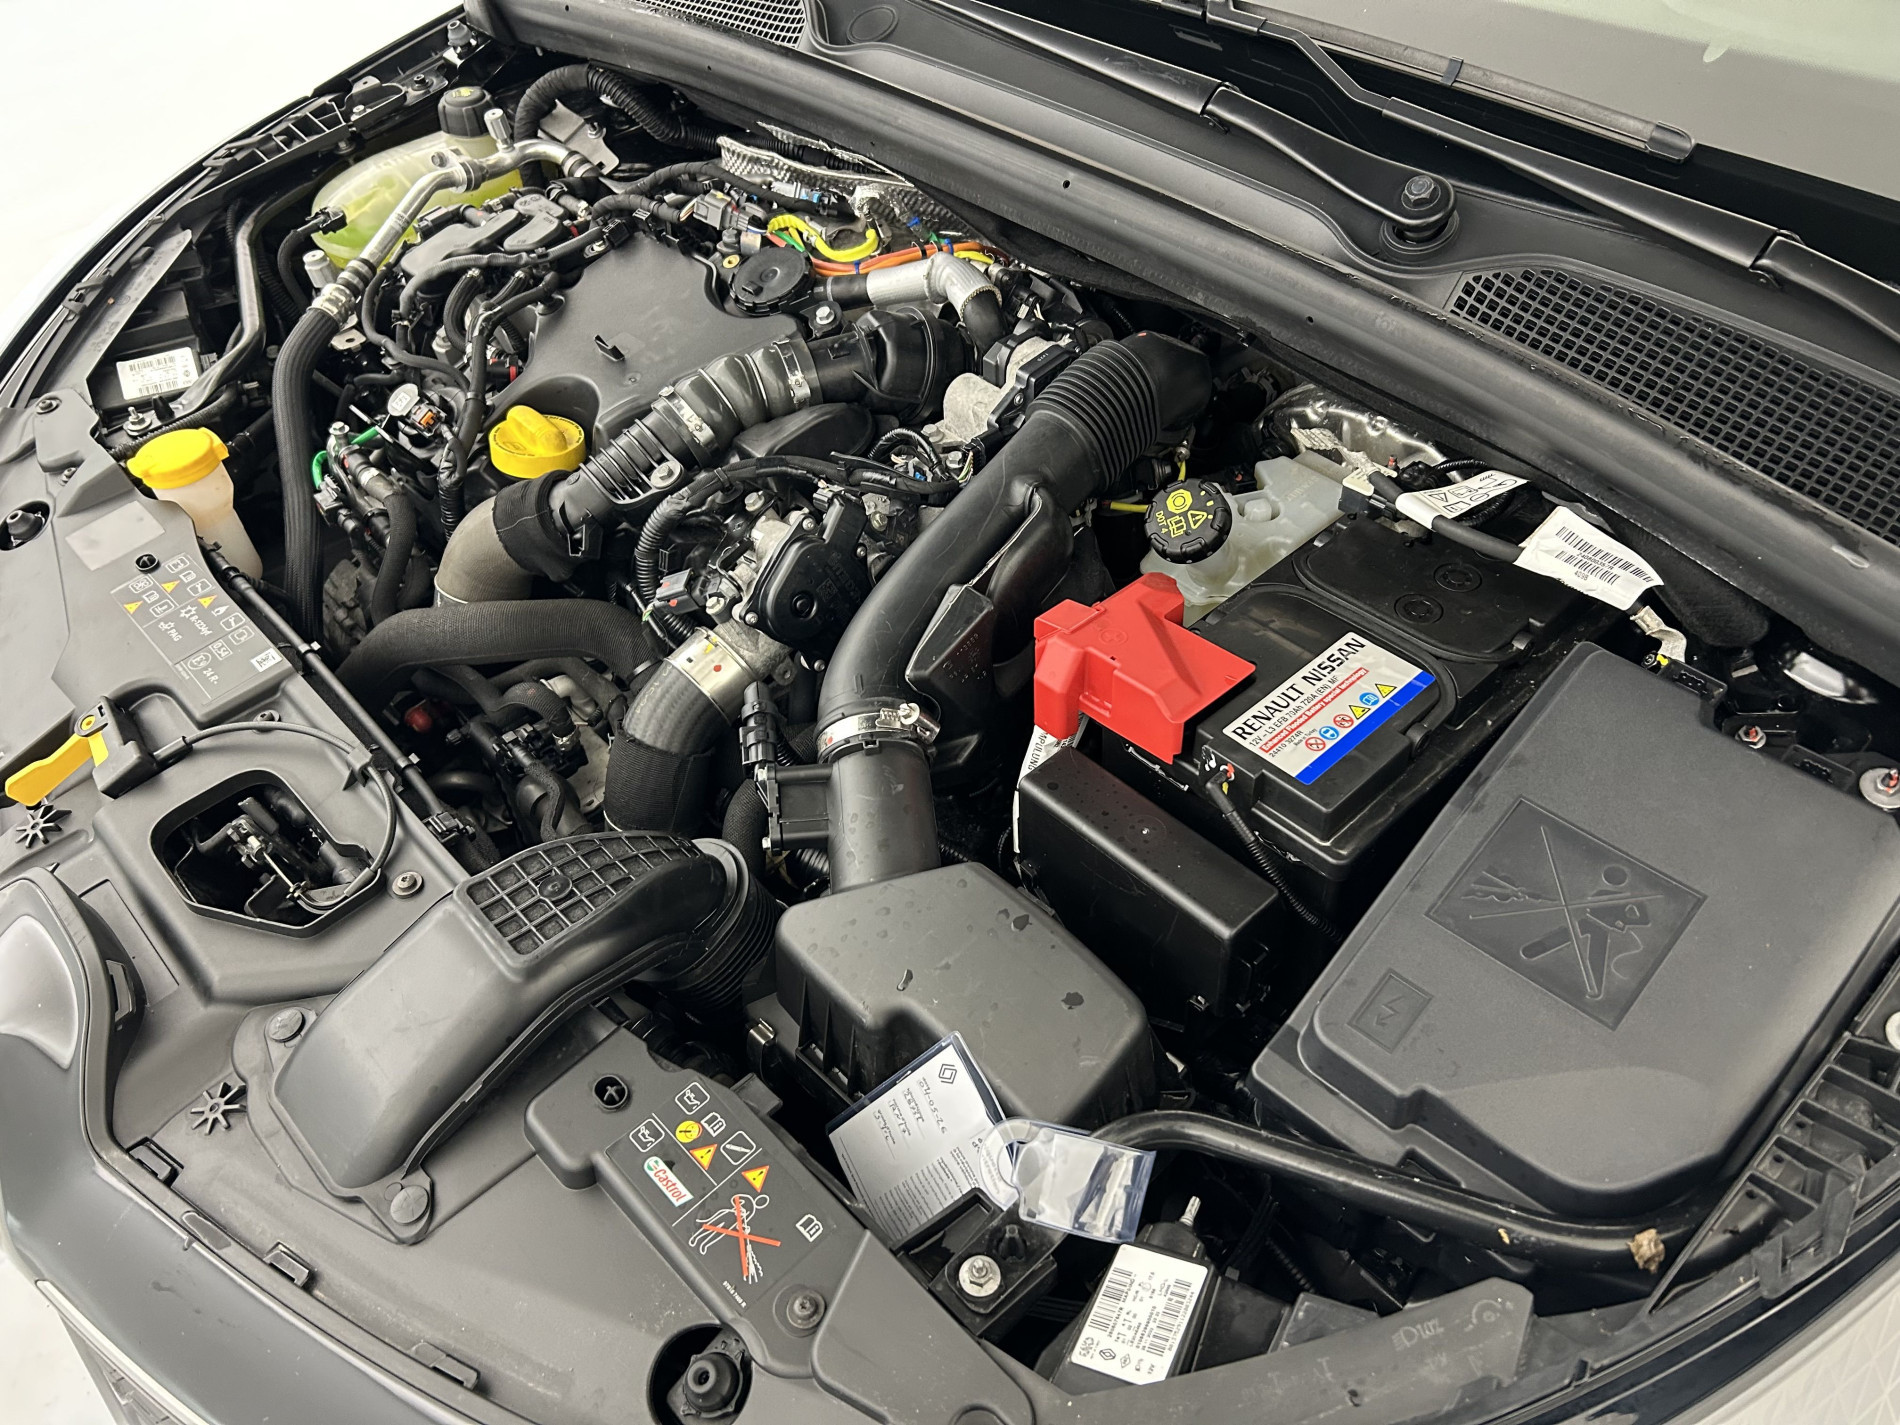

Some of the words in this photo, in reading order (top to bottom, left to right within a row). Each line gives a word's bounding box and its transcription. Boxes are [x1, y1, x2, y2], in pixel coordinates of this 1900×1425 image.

[1155, 510, 1167, 526] DOT
[167, 627, 182, 642] PAG
[202, 667, 213, 678] 24
[1232, 683, 1305, 741] RENAULT
[1301, 637, 1366, 686] NISSAN
[1249, 735, 1263, 747] 12V
[1267, 726, 1276, 735] L3
[1273, 716, 1288, 729] EFB
[1288, 704, 1303, 718] 70Ah
[1302, 692, 1318, 707] 720A
[1317, 683, 1331, 697] (EN)
[1328, 675, 1338, 685] MF
[1263, 729, 1287, 750] Enhanced
[1285, 714, 1306, 732] Flooded
[1304, 701, 1324, 718] Battery
[1322, 687, 1341, 705] special
[1339, 668, 1367, 691] technology
[1269, 743, 1286, 757] 24410
[1285, 730, 1303, 746] 3274R
[1305, 728, 1317, 738] Turkey
[653, 1168, 687, 1202] Castrol
